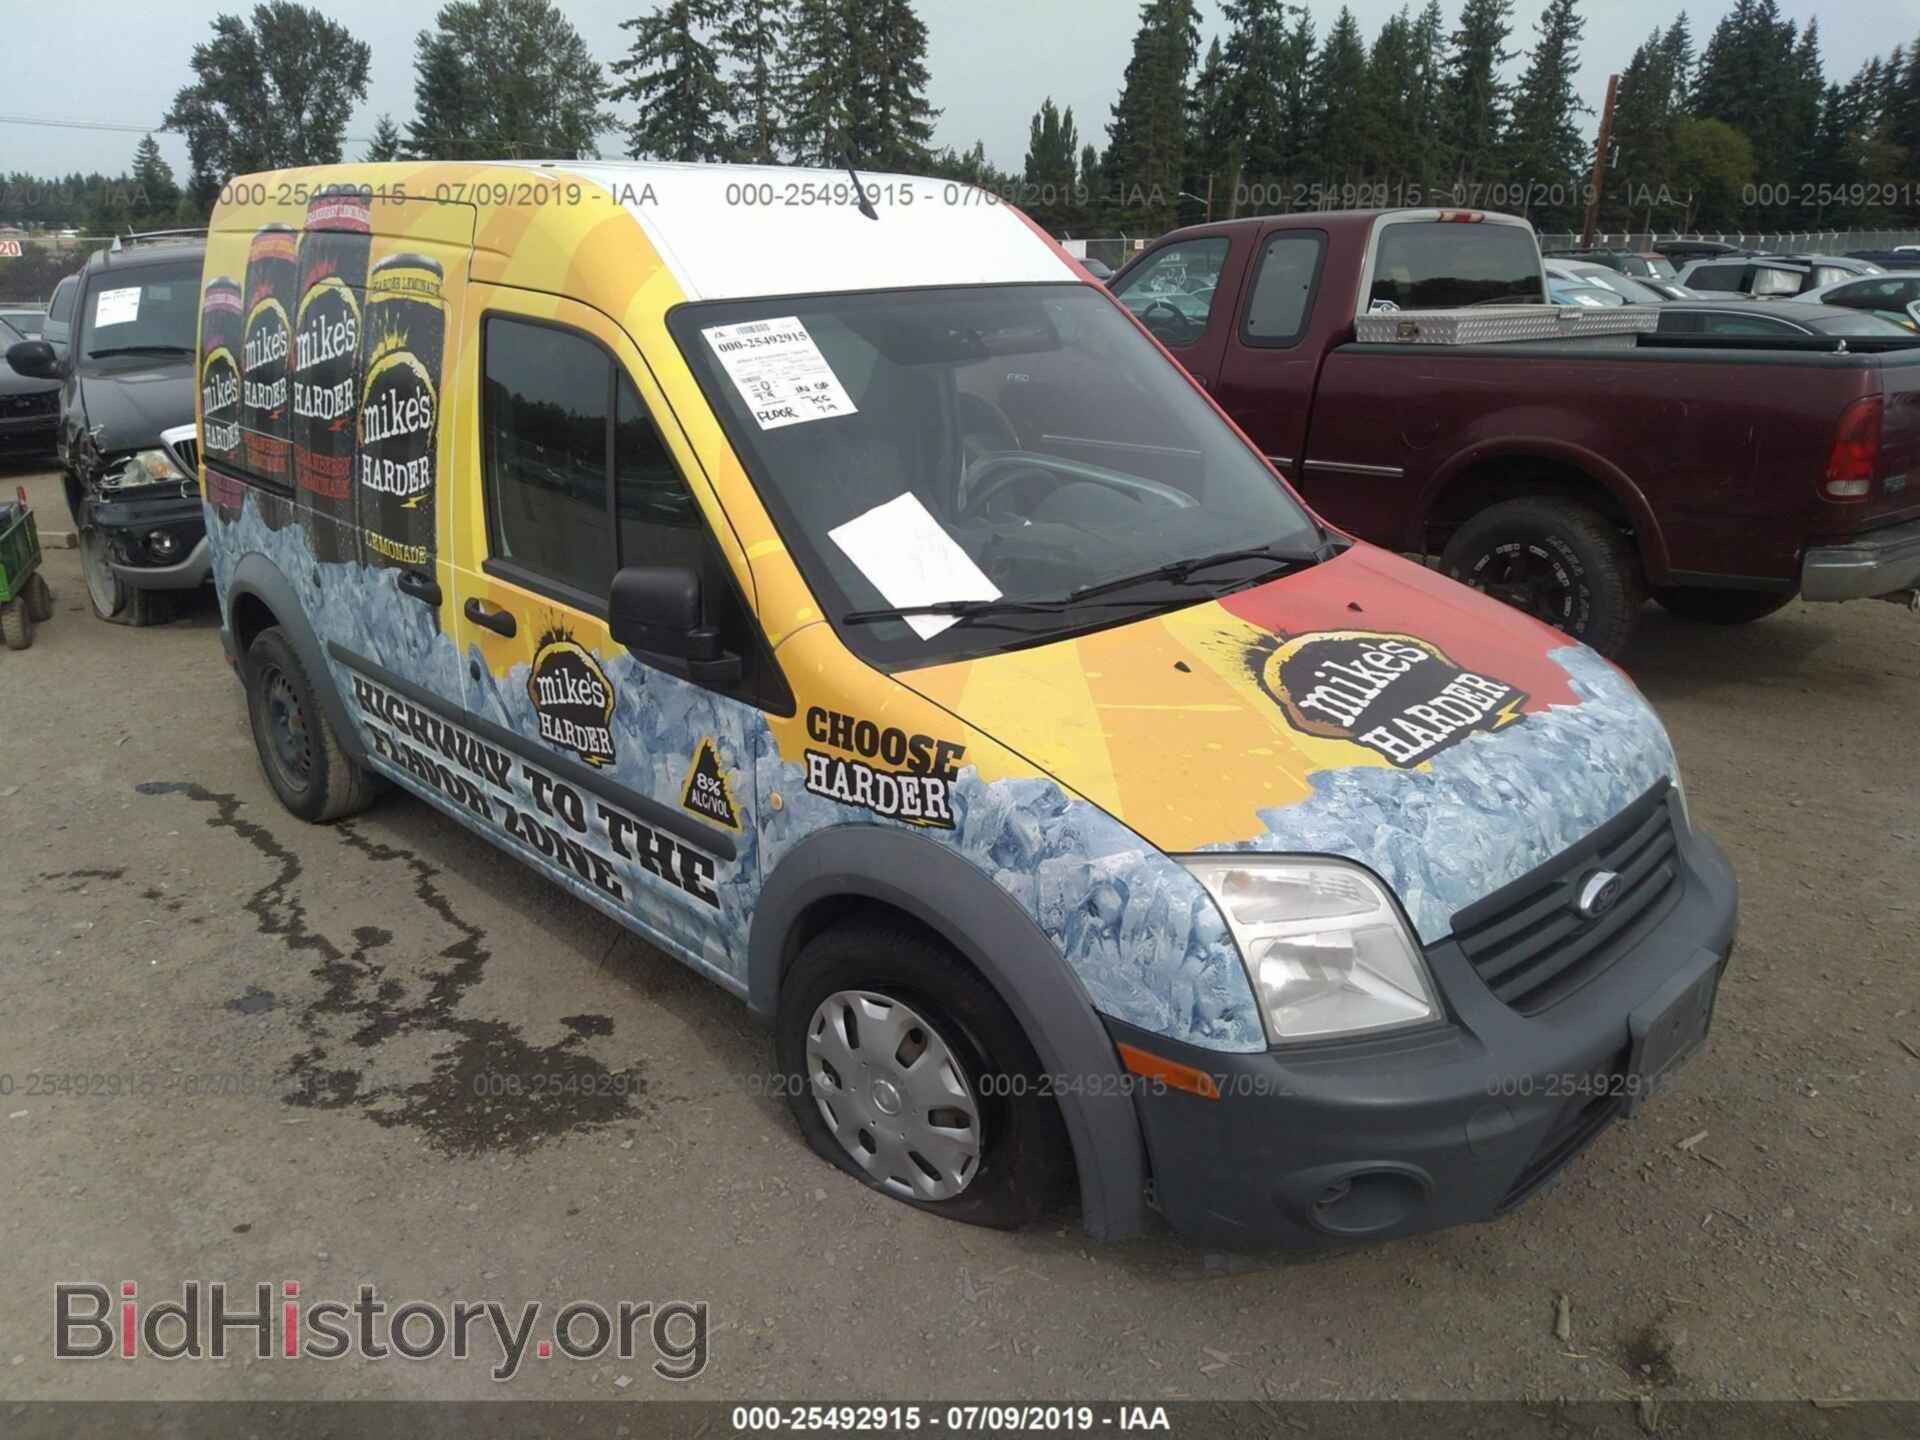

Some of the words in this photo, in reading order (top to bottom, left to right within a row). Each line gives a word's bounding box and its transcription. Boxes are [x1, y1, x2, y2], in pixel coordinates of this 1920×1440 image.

[244, 324, 288, 372] mike's
[296, 311, 356, 372] mike's
[718, 331, 808, 352] 000-25492915
[203, 371, 239, 415] mike's
[244, 377, 287, 411] HARDER
[293, 378, 354, 420] HARDER
[204, 421, 240, 450] HARDER
[364, 387, 431, 444] mike's
[362, 454, 431, 496] HARDER
[364, 530, 426, 564] LEMONADE
[537, 668, 606, 708] mike's
[1299, 641, 1430, 728] mike's
[539, 712, 614, 755] HARDER
[1358, 672, 1512, 763] HARDER
[806, 706, 967, 782] CHOOSE
[353, 675, 514, 794] HIGHWAY
[522, 764, 588, 833] TO
[596, 802, 721, 910] THE
[696, 772, 721, 797] 8%
[806, 752, 951, 819] HARDER
[364, 720, 495, 822] FLAVOR
[493, 795, 626, 902] ZONE
